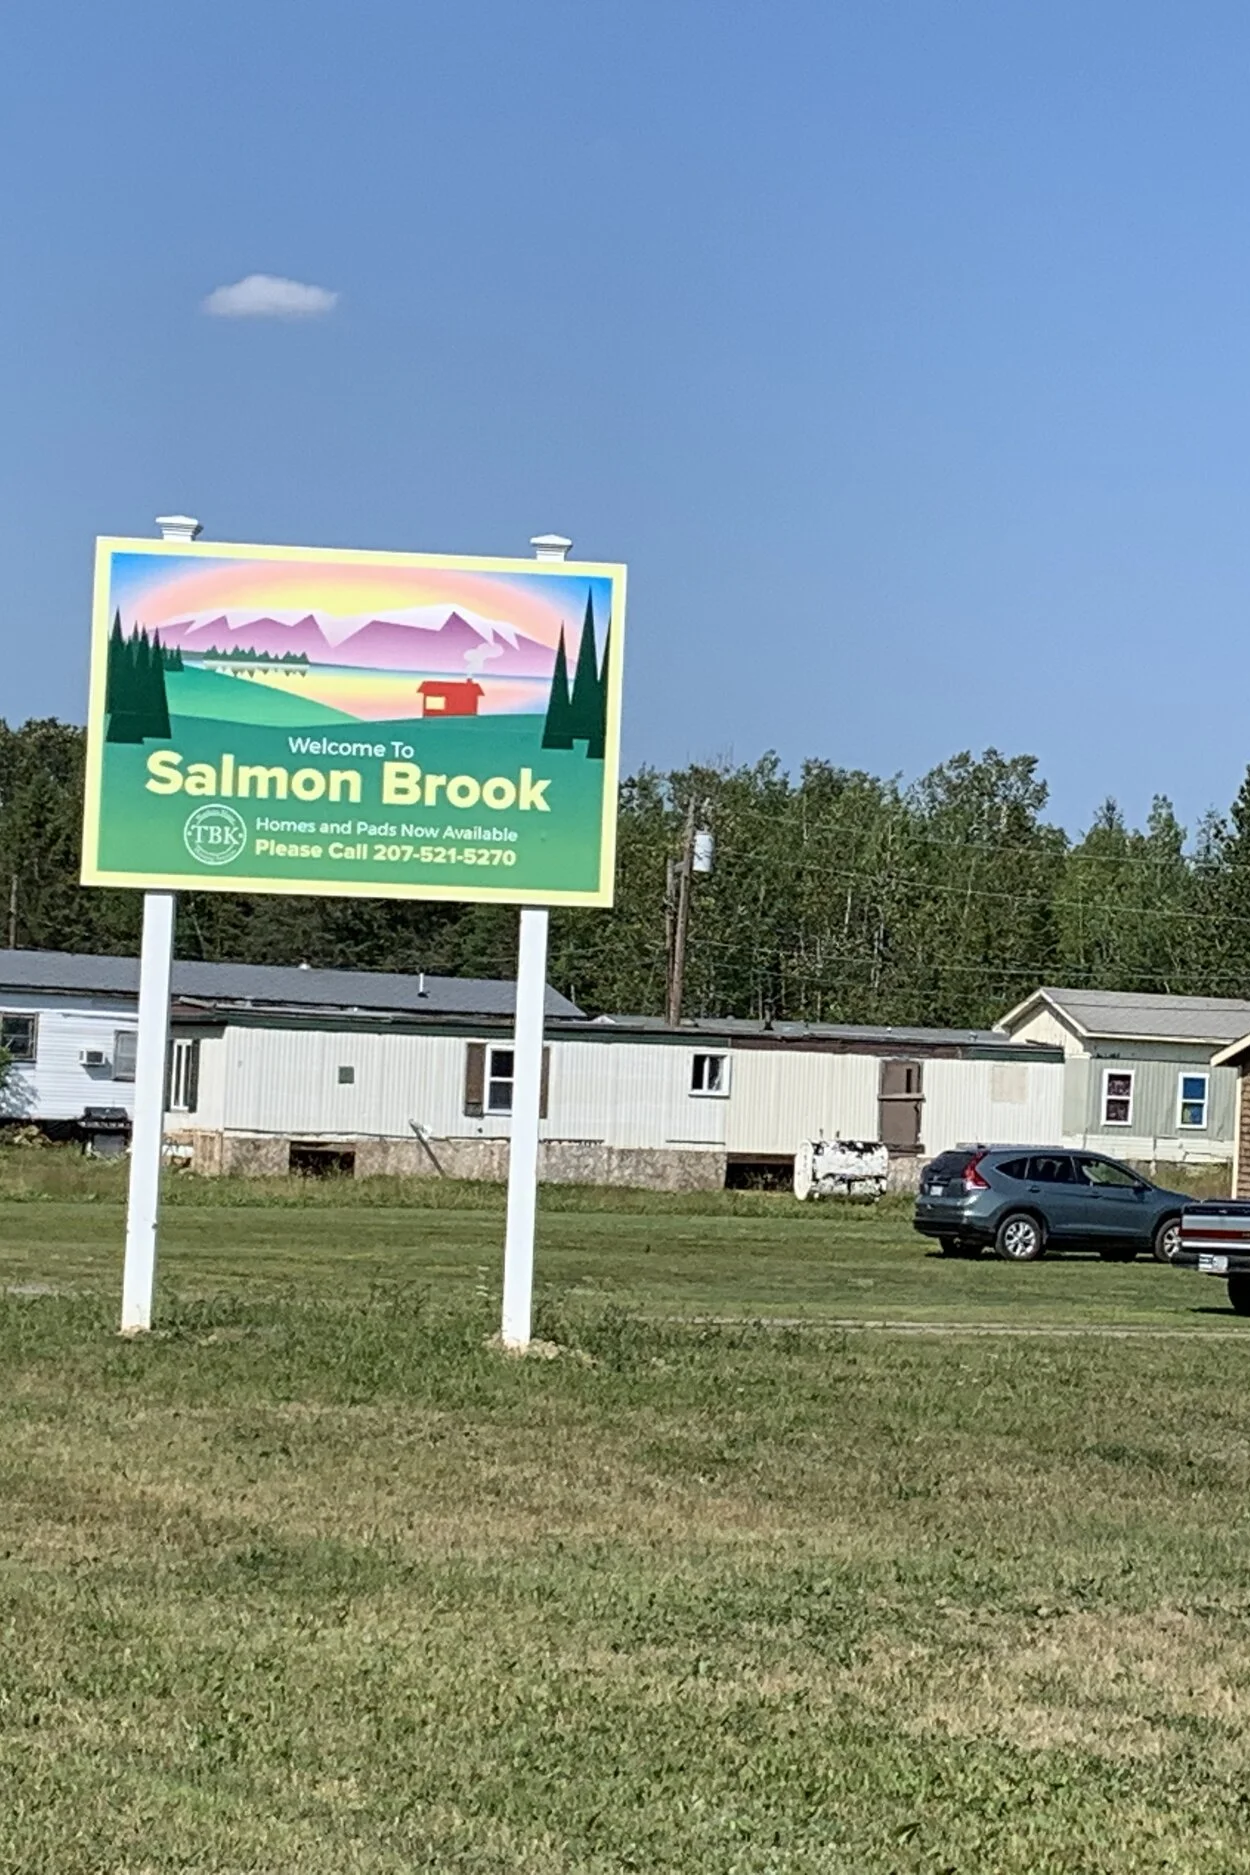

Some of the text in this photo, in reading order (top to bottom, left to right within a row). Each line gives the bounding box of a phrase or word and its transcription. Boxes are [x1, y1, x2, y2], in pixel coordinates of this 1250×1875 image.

[288, 736, 415, 759] Welcome To
[145, 750, 552, 812] Salmon Brook
[190, 825, 240, 845] TBK
[255, 817, 518, 842] Homes and Pads Now Available
[255, 839, 323, 858] Please
[328, 842, 368, 860] Call
[373, 844, 516, 866] 207-521-5270
